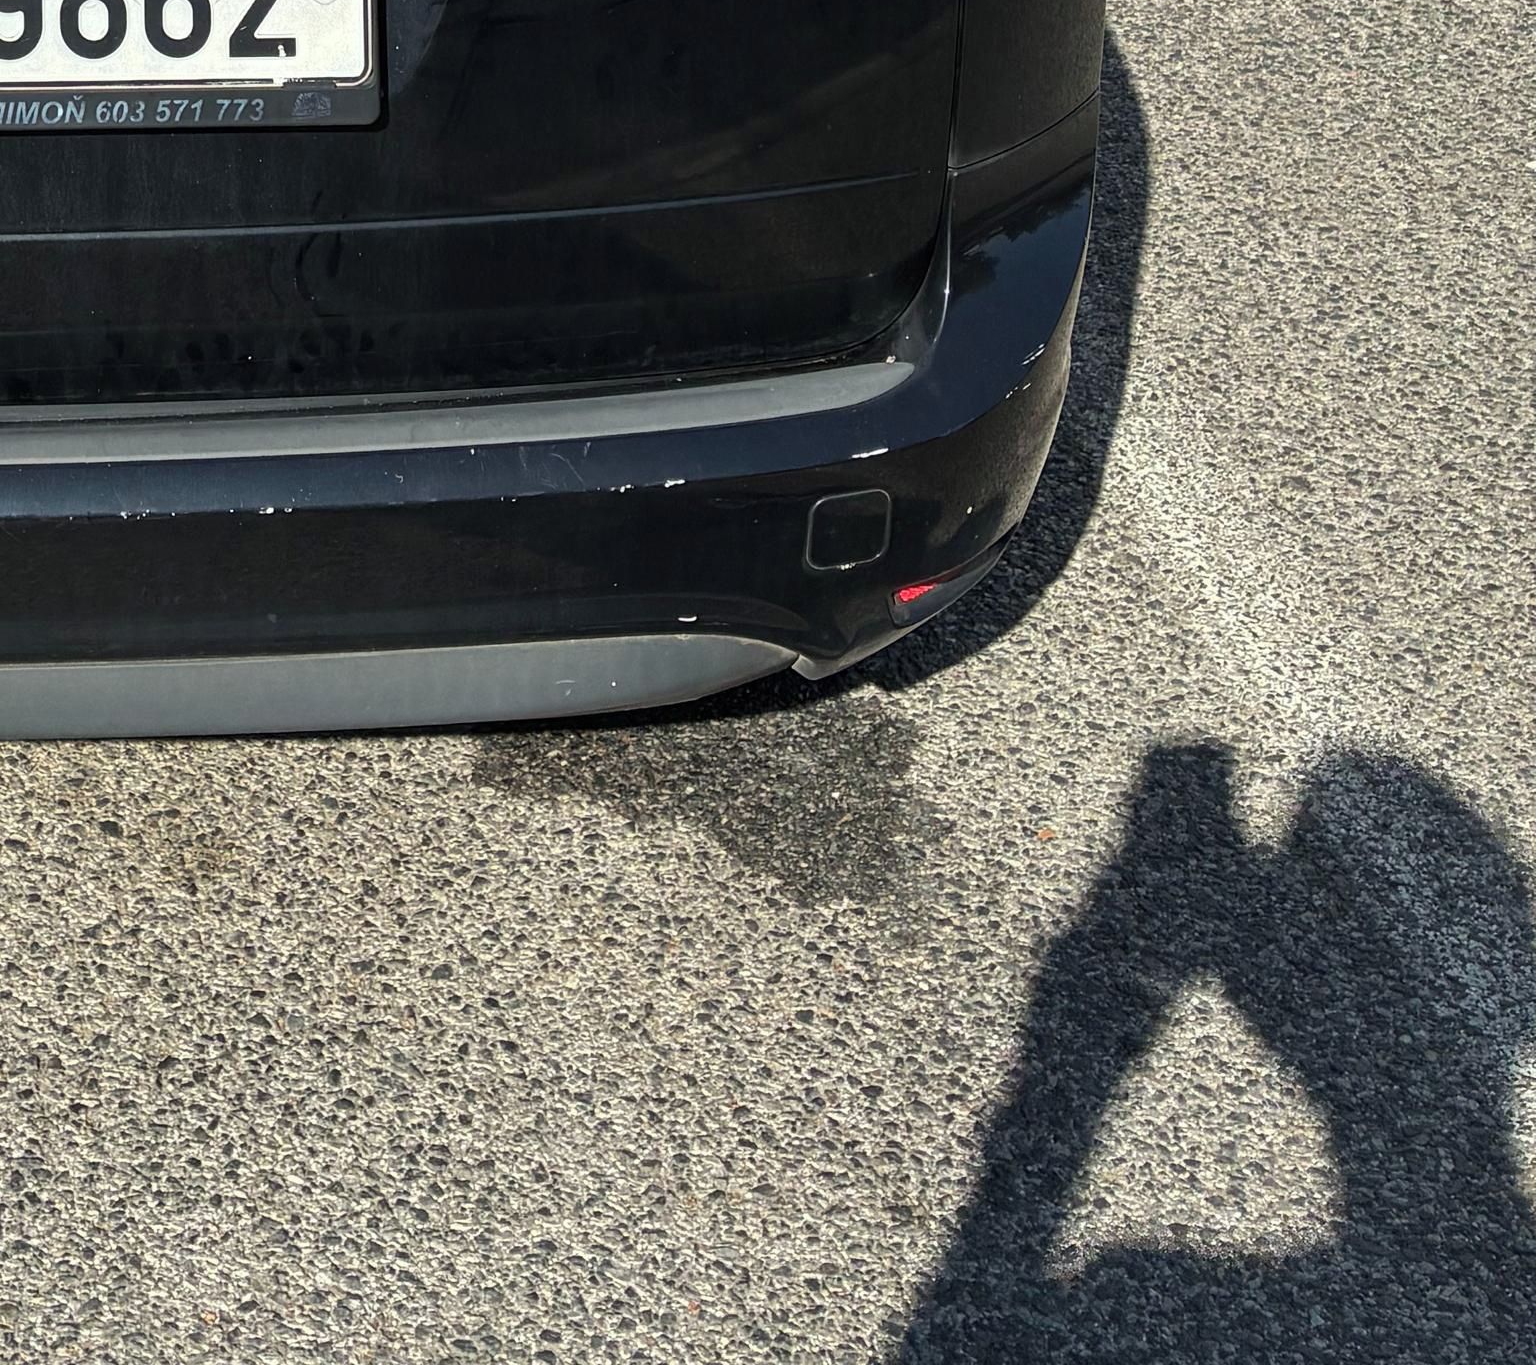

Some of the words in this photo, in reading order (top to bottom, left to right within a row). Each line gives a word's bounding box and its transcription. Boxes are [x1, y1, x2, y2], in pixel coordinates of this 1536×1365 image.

[95, 100, 145, 124] 603
[155, 99, 202, 123] 571
[215, 98, 265, 122] 773
